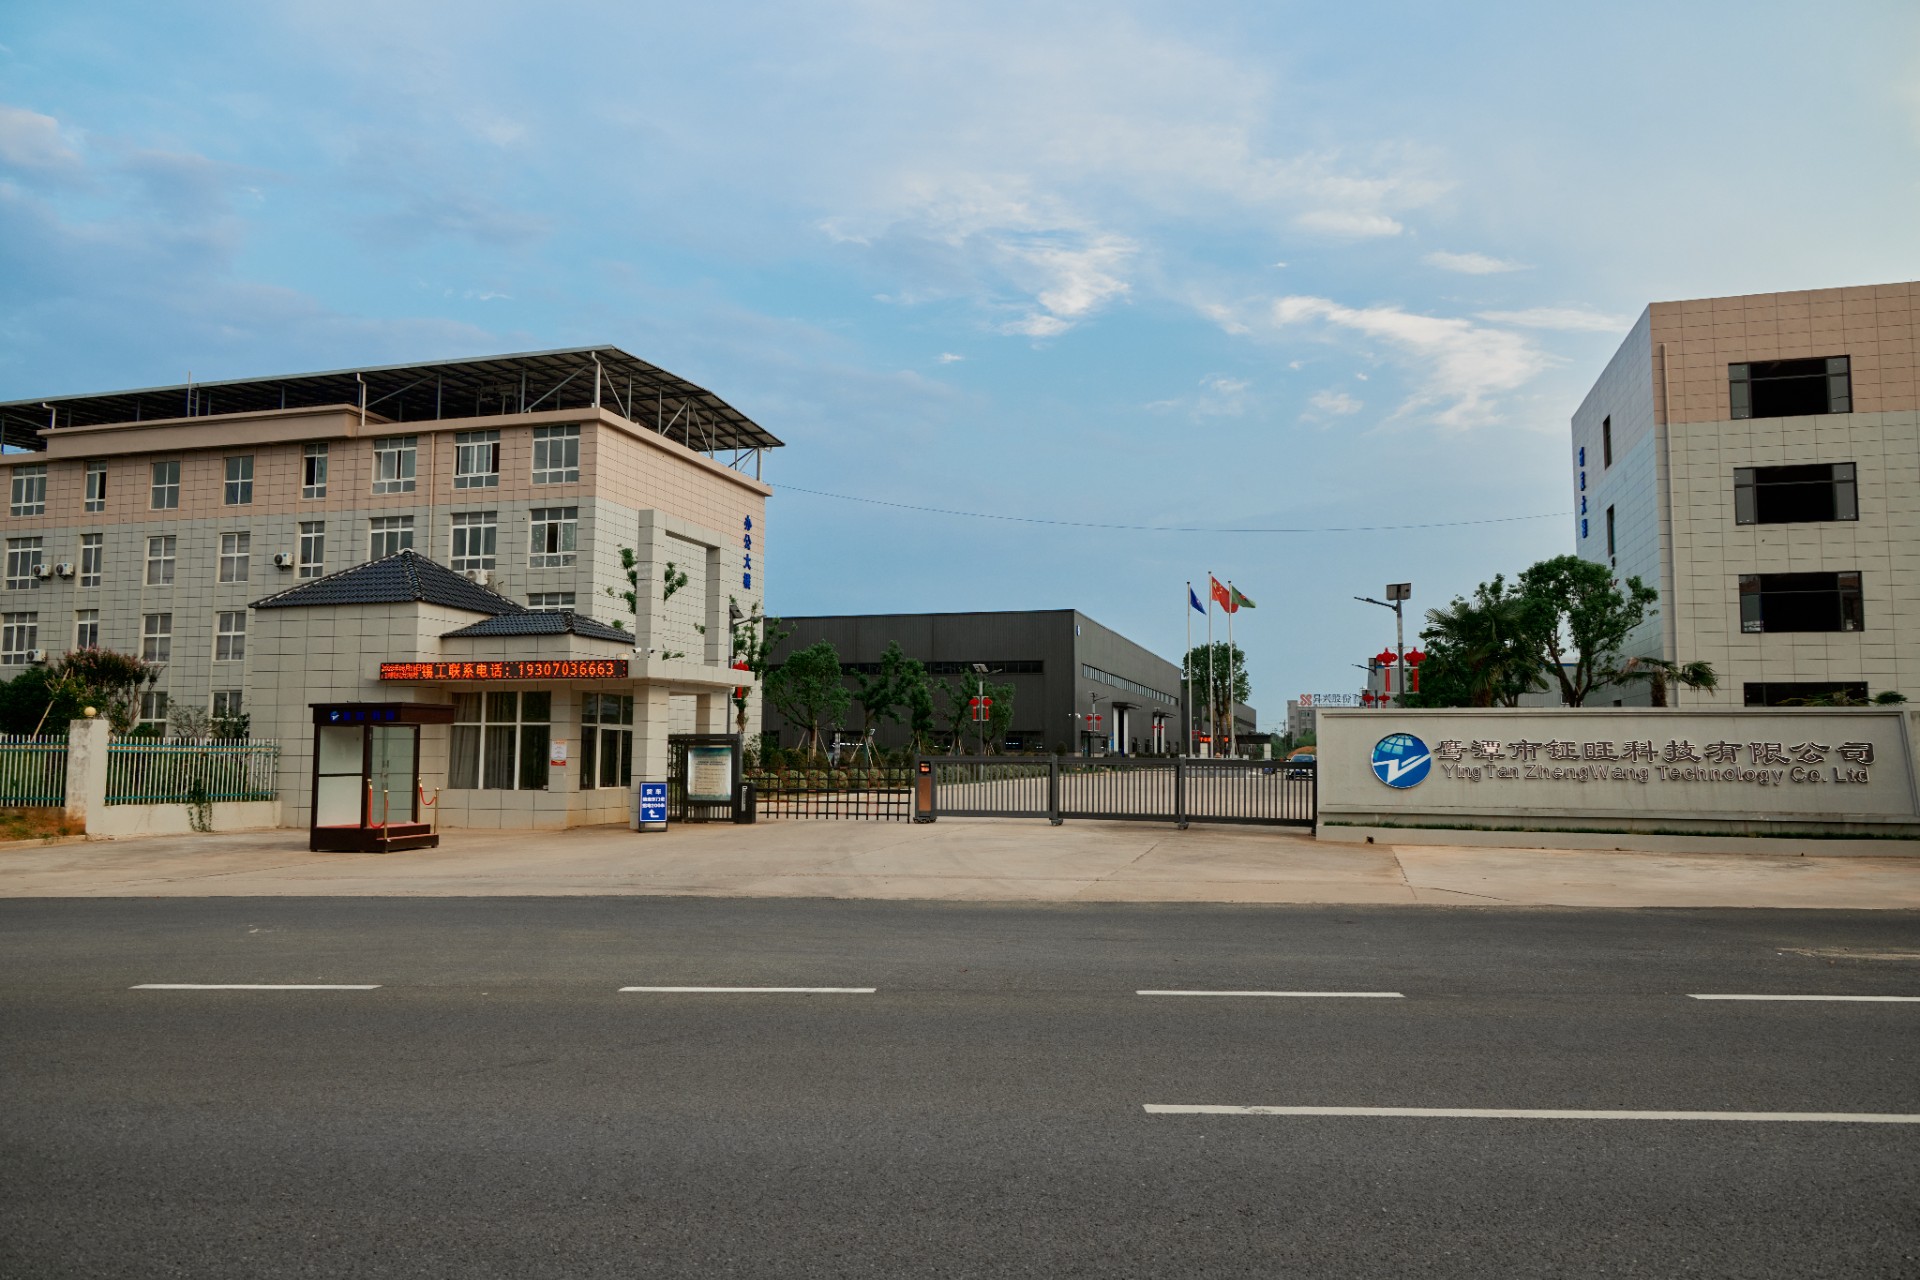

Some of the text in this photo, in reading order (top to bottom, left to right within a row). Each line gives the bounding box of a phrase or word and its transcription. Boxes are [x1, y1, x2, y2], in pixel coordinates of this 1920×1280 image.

[1434, 739, 1875, 765] 鹰潭市钲旺科技有限公司
[1524, 764, 1649, 783] ZhengWang
[1655, 765, 1784, 786] Technology
[1790, 766, 1828, 783] Co.
[1833, 766, 1870, 784] Ltd
